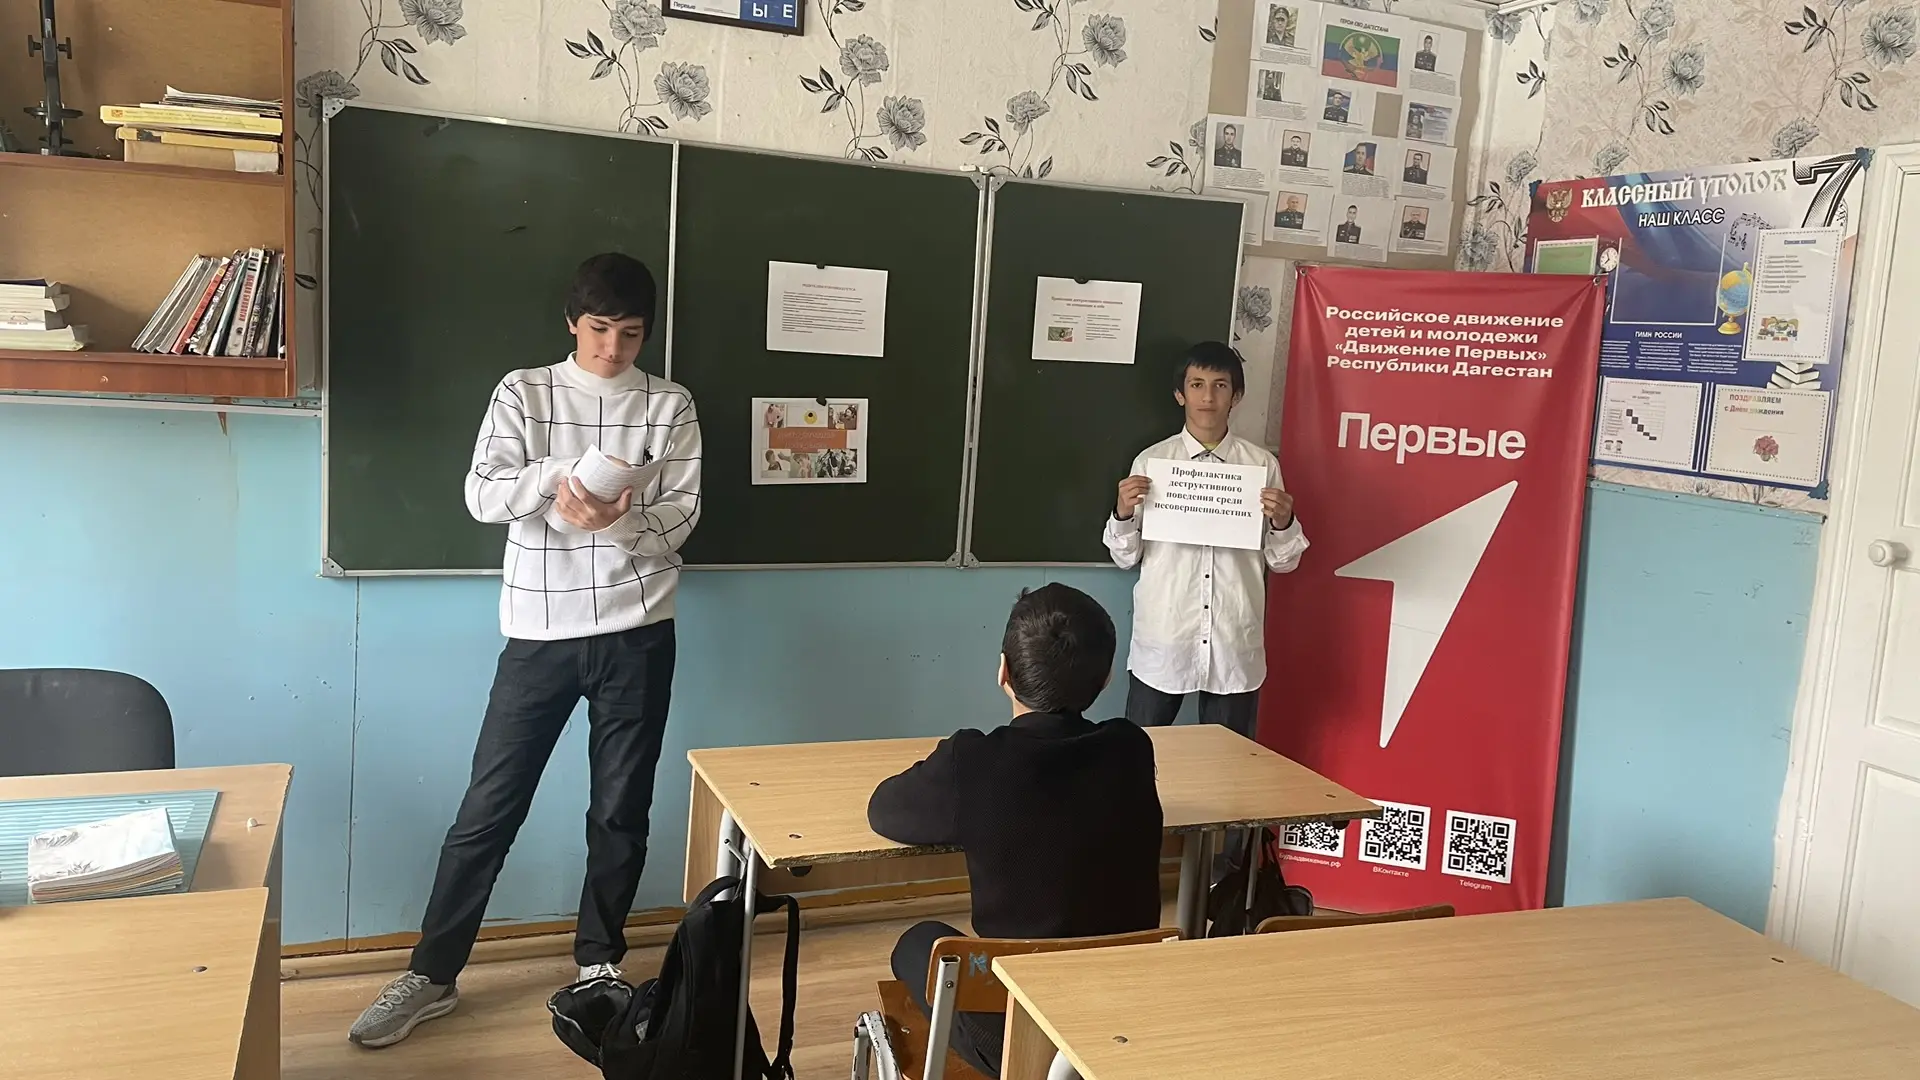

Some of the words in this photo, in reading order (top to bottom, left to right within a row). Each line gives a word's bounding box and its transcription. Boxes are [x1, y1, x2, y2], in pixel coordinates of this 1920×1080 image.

[673, 1, 697, 10] Первые
[753, 3, 768, 19] Ы
[783, 4, 793, 19] Е
[1580, 175, 1695, 208] КЛАССНЫЙ
[1699, 168, 1787, 204] УГОЛОК
[1638, 211, 1671, 228] НАШ
[1672, 207, 1725, 226] КЛАСС
[1325, 305, 1450, 324] Российское
[1453, 313, 1564, 328] движение
[1344, 324, 1405, 339] детей
[1409, 328, 1423, 339] и
[1427, 330, 1538, 344] молодежи
[1634, 330, 1652, 338] ГИМН
[1654, 331, 1683, 339] РОССИИ
[1335, 340, 1450, 357] «Движение
[1455, 345, 1547, 362] Первых»
[1327, 355, 1449, 374] Республики
[1452, 362, 1553, 379] Дагестан
[1338, 411, 1526, 464] Первые
[1171, 466, 1242, 481] Профилактика
[1168, 480, 1243, 493] деструктивного
[1166, 491, 1214, 503] поведения
[1216, 495, 1243, 505] среди
[1154, 501, 1253, 518] несовершеннолетних
[1372, 866, 1410, 878] ВКонтакте
[1459, 879, 1493, 891] Telegram
